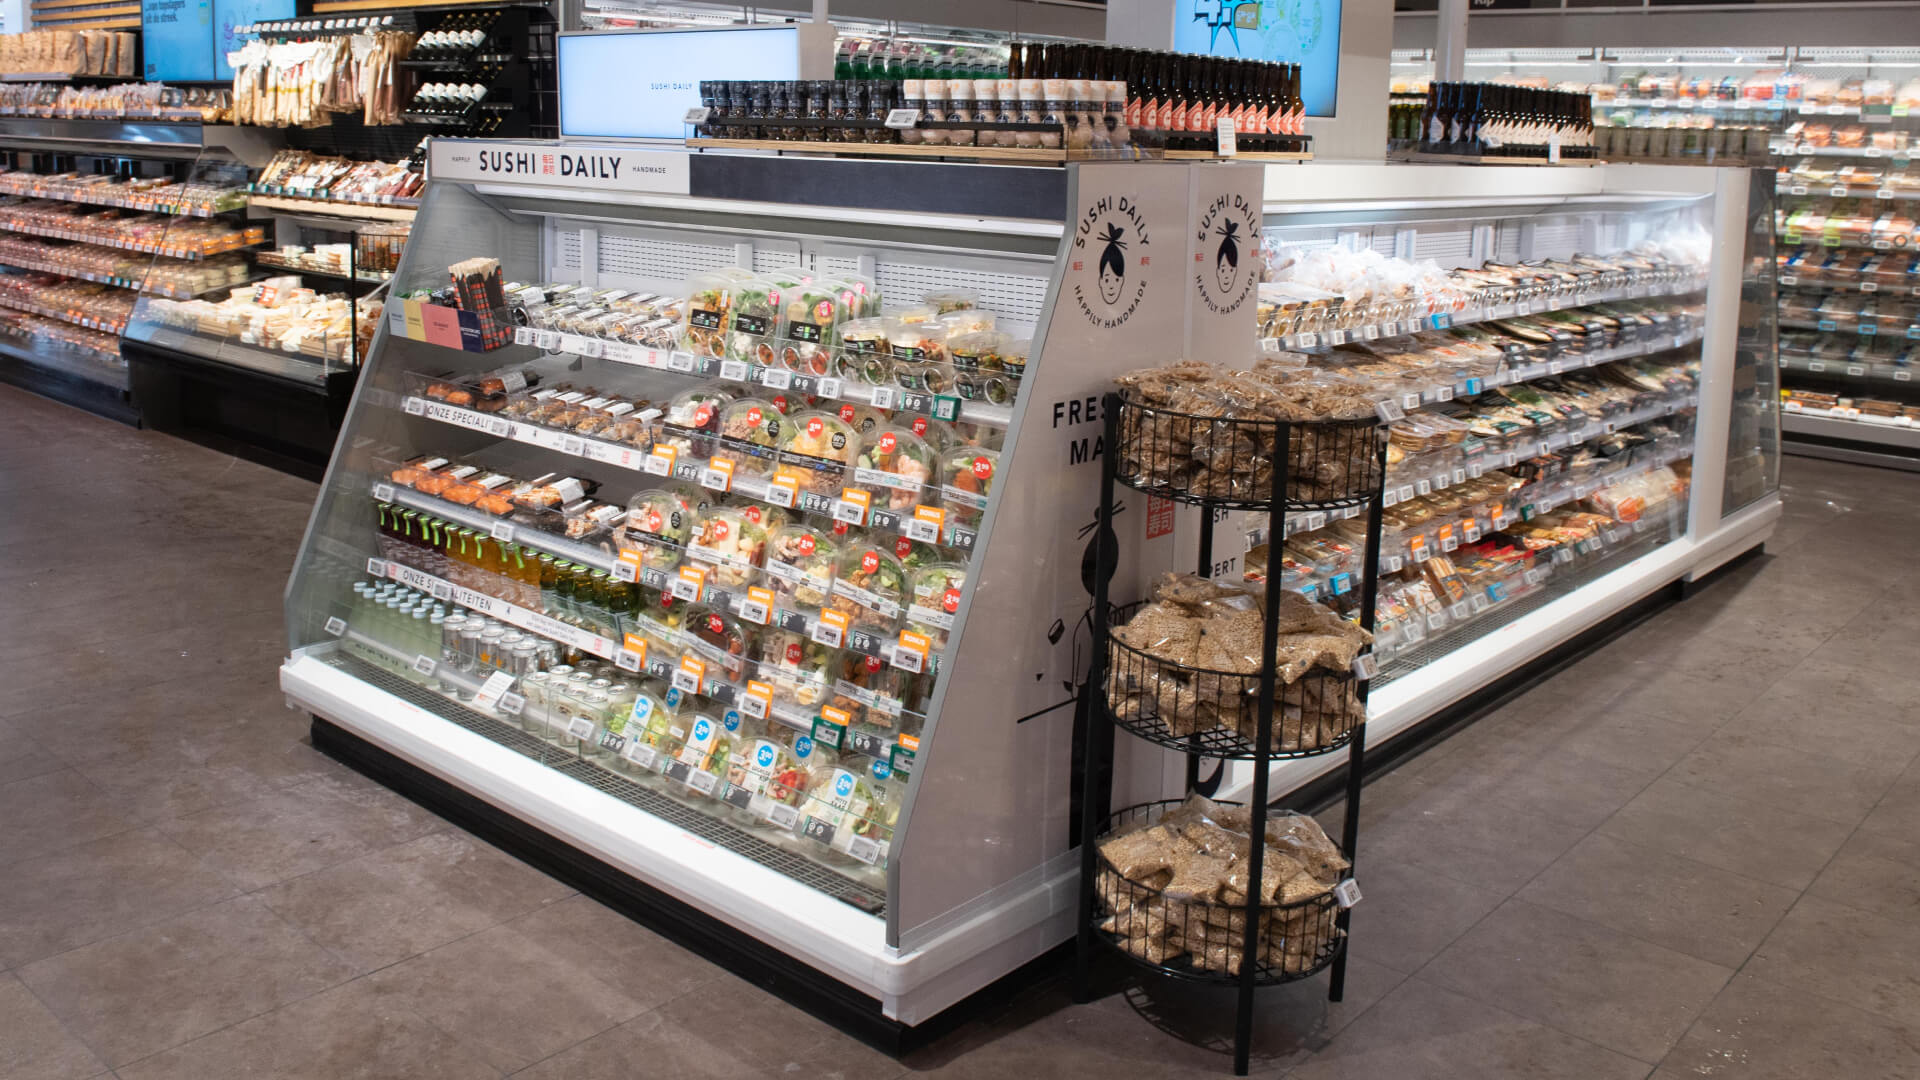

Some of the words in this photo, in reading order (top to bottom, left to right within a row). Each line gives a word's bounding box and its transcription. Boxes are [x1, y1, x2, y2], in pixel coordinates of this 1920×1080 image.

[651, 82, 670, 90] SUSHI
[672, 82, 692, 90] DAILY
[480, 150, 536, 174] SUSHI
[561, 154, 622, 179] DAILY
[632, 166, 667, 174] HANDMADE
[1076, 195, 1112, 249] SUSHI
[1119, 196, 1150, 246] DAILY
[1198, 193, 1229, 242] SUSHI
[1235, 194, 1259, 239] DAILY
[1074, 284, 1102, 327] HAPPILY
[1104, 280, 1147, 329] HANDMADE
[1196, 274, 1219, 313] HAPPILY
[1220, 270, 1255, 315] HANDMADE
[428, 405, 449, 419] ONZE
[403, 570, 425, 586] ONZE
